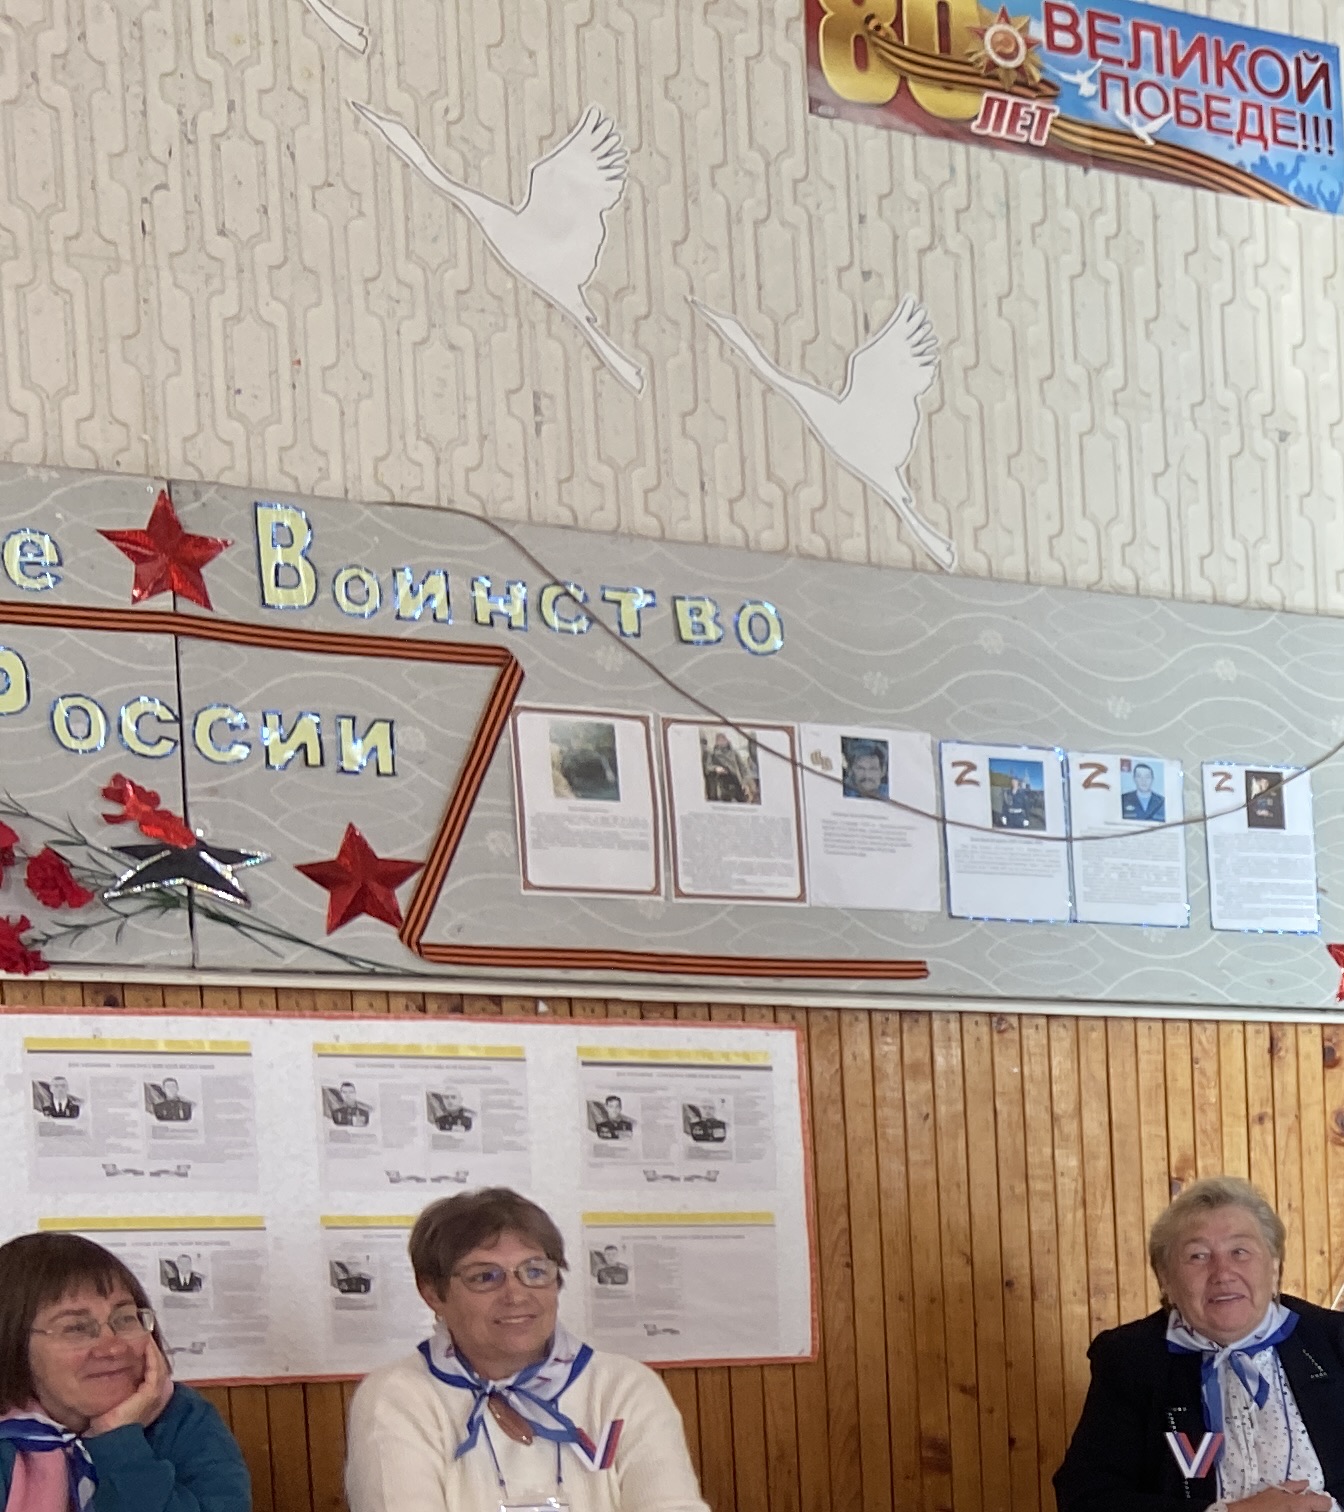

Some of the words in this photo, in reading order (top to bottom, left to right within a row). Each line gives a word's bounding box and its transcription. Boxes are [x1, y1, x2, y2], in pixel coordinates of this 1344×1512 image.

[1044, 1, 1333, 111] ВЕЛИКОЙ
[971, 91, 1060, 148] ЛЕТ
[1100, 74, 1335, 156] ПОБЕДЕ!!!
[254, 501, 785, 656] Воинство
